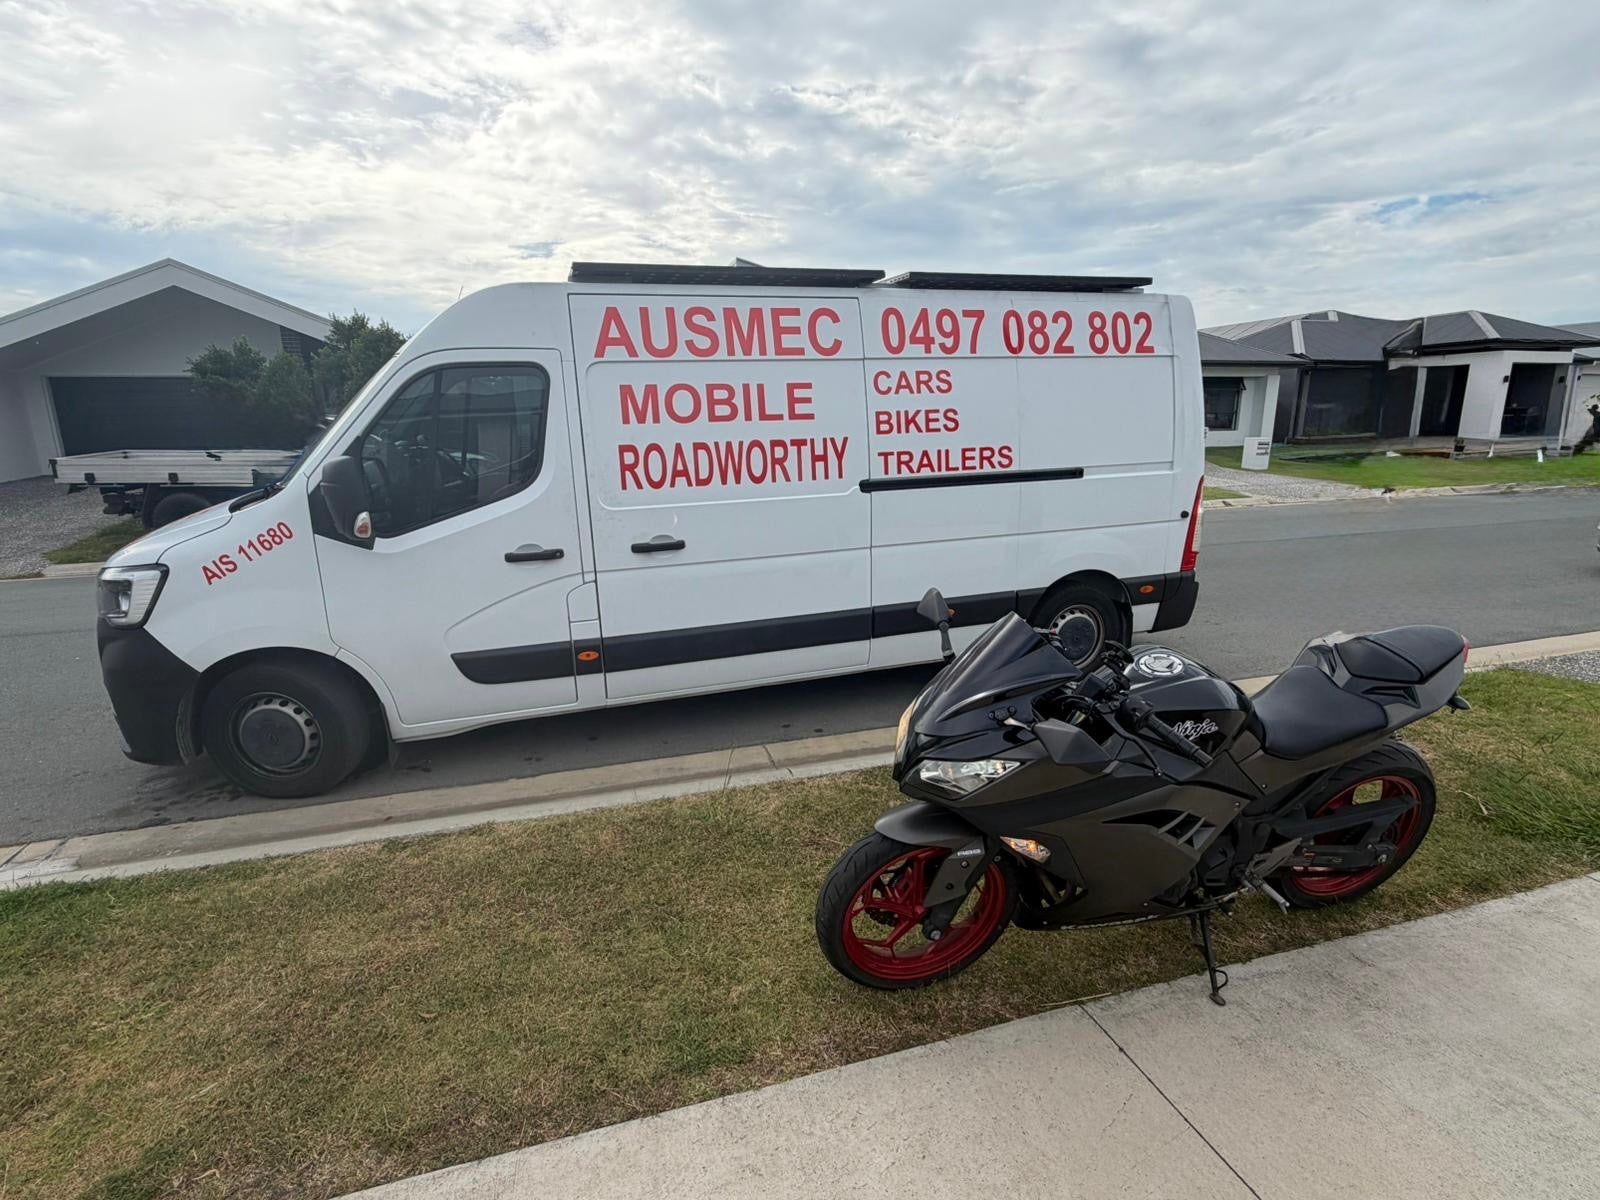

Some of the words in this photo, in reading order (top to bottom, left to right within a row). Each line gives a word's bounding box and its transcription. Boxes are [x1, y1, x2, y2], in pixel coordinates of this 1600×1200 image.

[595, 307, 843, 359] AUSMEC
[881, 307, 986, 357] 0497
[1003, 310, 1076, 356] 082
[1087, 311, 1156, 355] 802
[620, 383, 816, 425] MOBILE
[873, 370, 953, 396] CARS
[875, 408, 960, 436] BIKES
[619, 436, 850, 491] ROADWORTHY
[878, 446, 1014, 476] TRAILERS
[201, 554, 238, 586] AIS
[237, 521, 294, 562] 11680
